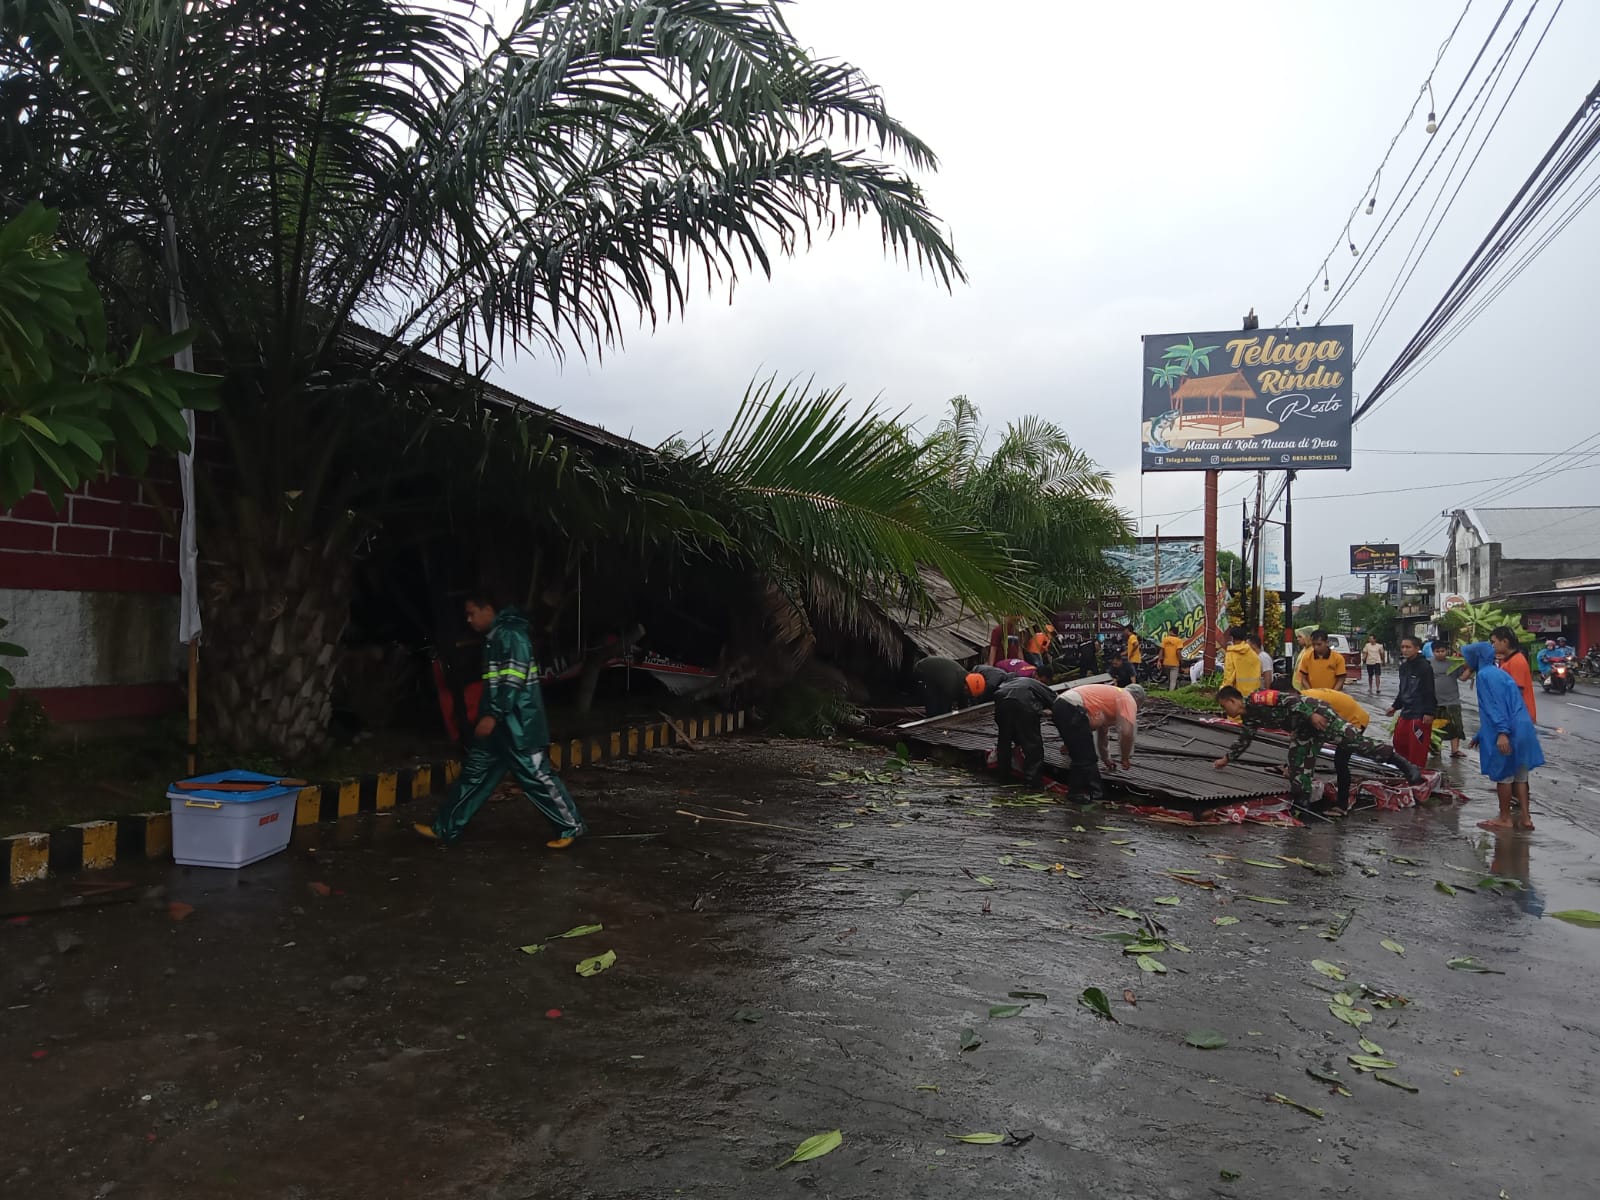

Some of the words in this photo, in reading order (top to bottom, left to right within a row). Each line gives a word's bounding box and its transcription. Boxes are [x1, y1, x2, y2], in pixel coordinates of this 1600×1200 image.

[1225, 335, 1344, 372] Telaga
[1257, 365, 1344, 395] Rindu
[1266, 393, 1343, 422] Resto
[1182, 439, 1219, 452] Makan
[1221, 438, 1233, 450] di
[1261, 437, 1297, 450] Nuasa
[1297, 435, 1310, 449] di
[1311, 437, 1339, 450] Desa
